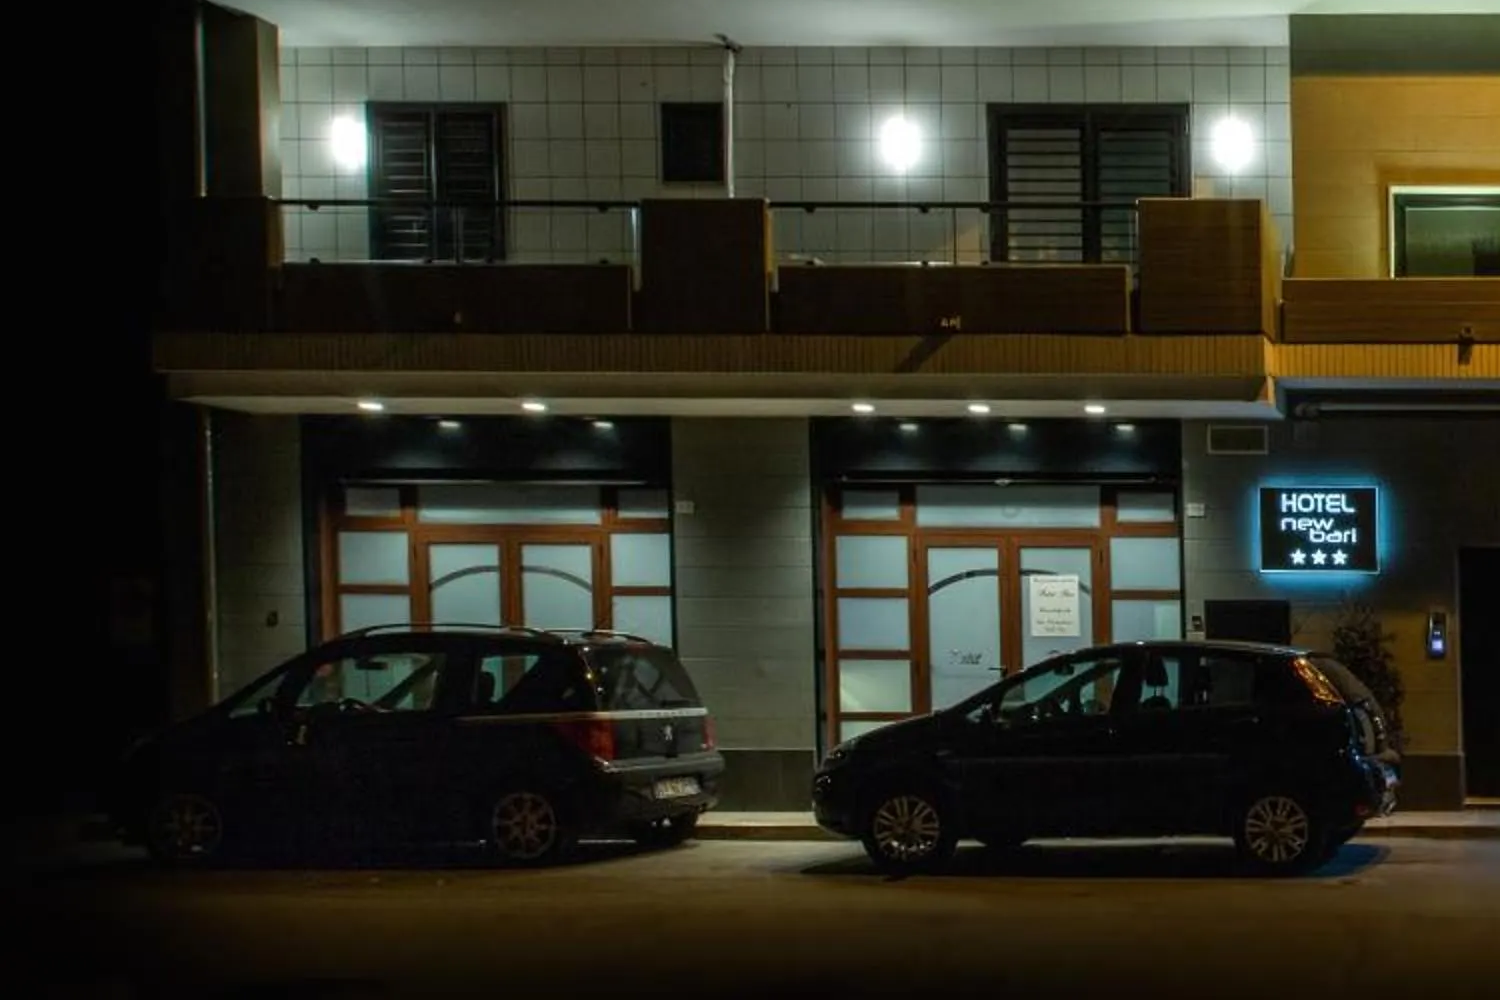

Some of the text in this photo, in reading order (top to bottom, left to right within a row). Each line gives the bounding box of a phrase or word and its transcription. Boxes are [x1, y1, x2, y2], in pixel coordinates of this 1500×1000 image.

[1281, 493, 1355, 513] HOTEL
[1281, 517, 1334, 531] new
[1309, 527, 1357, 543] bari
